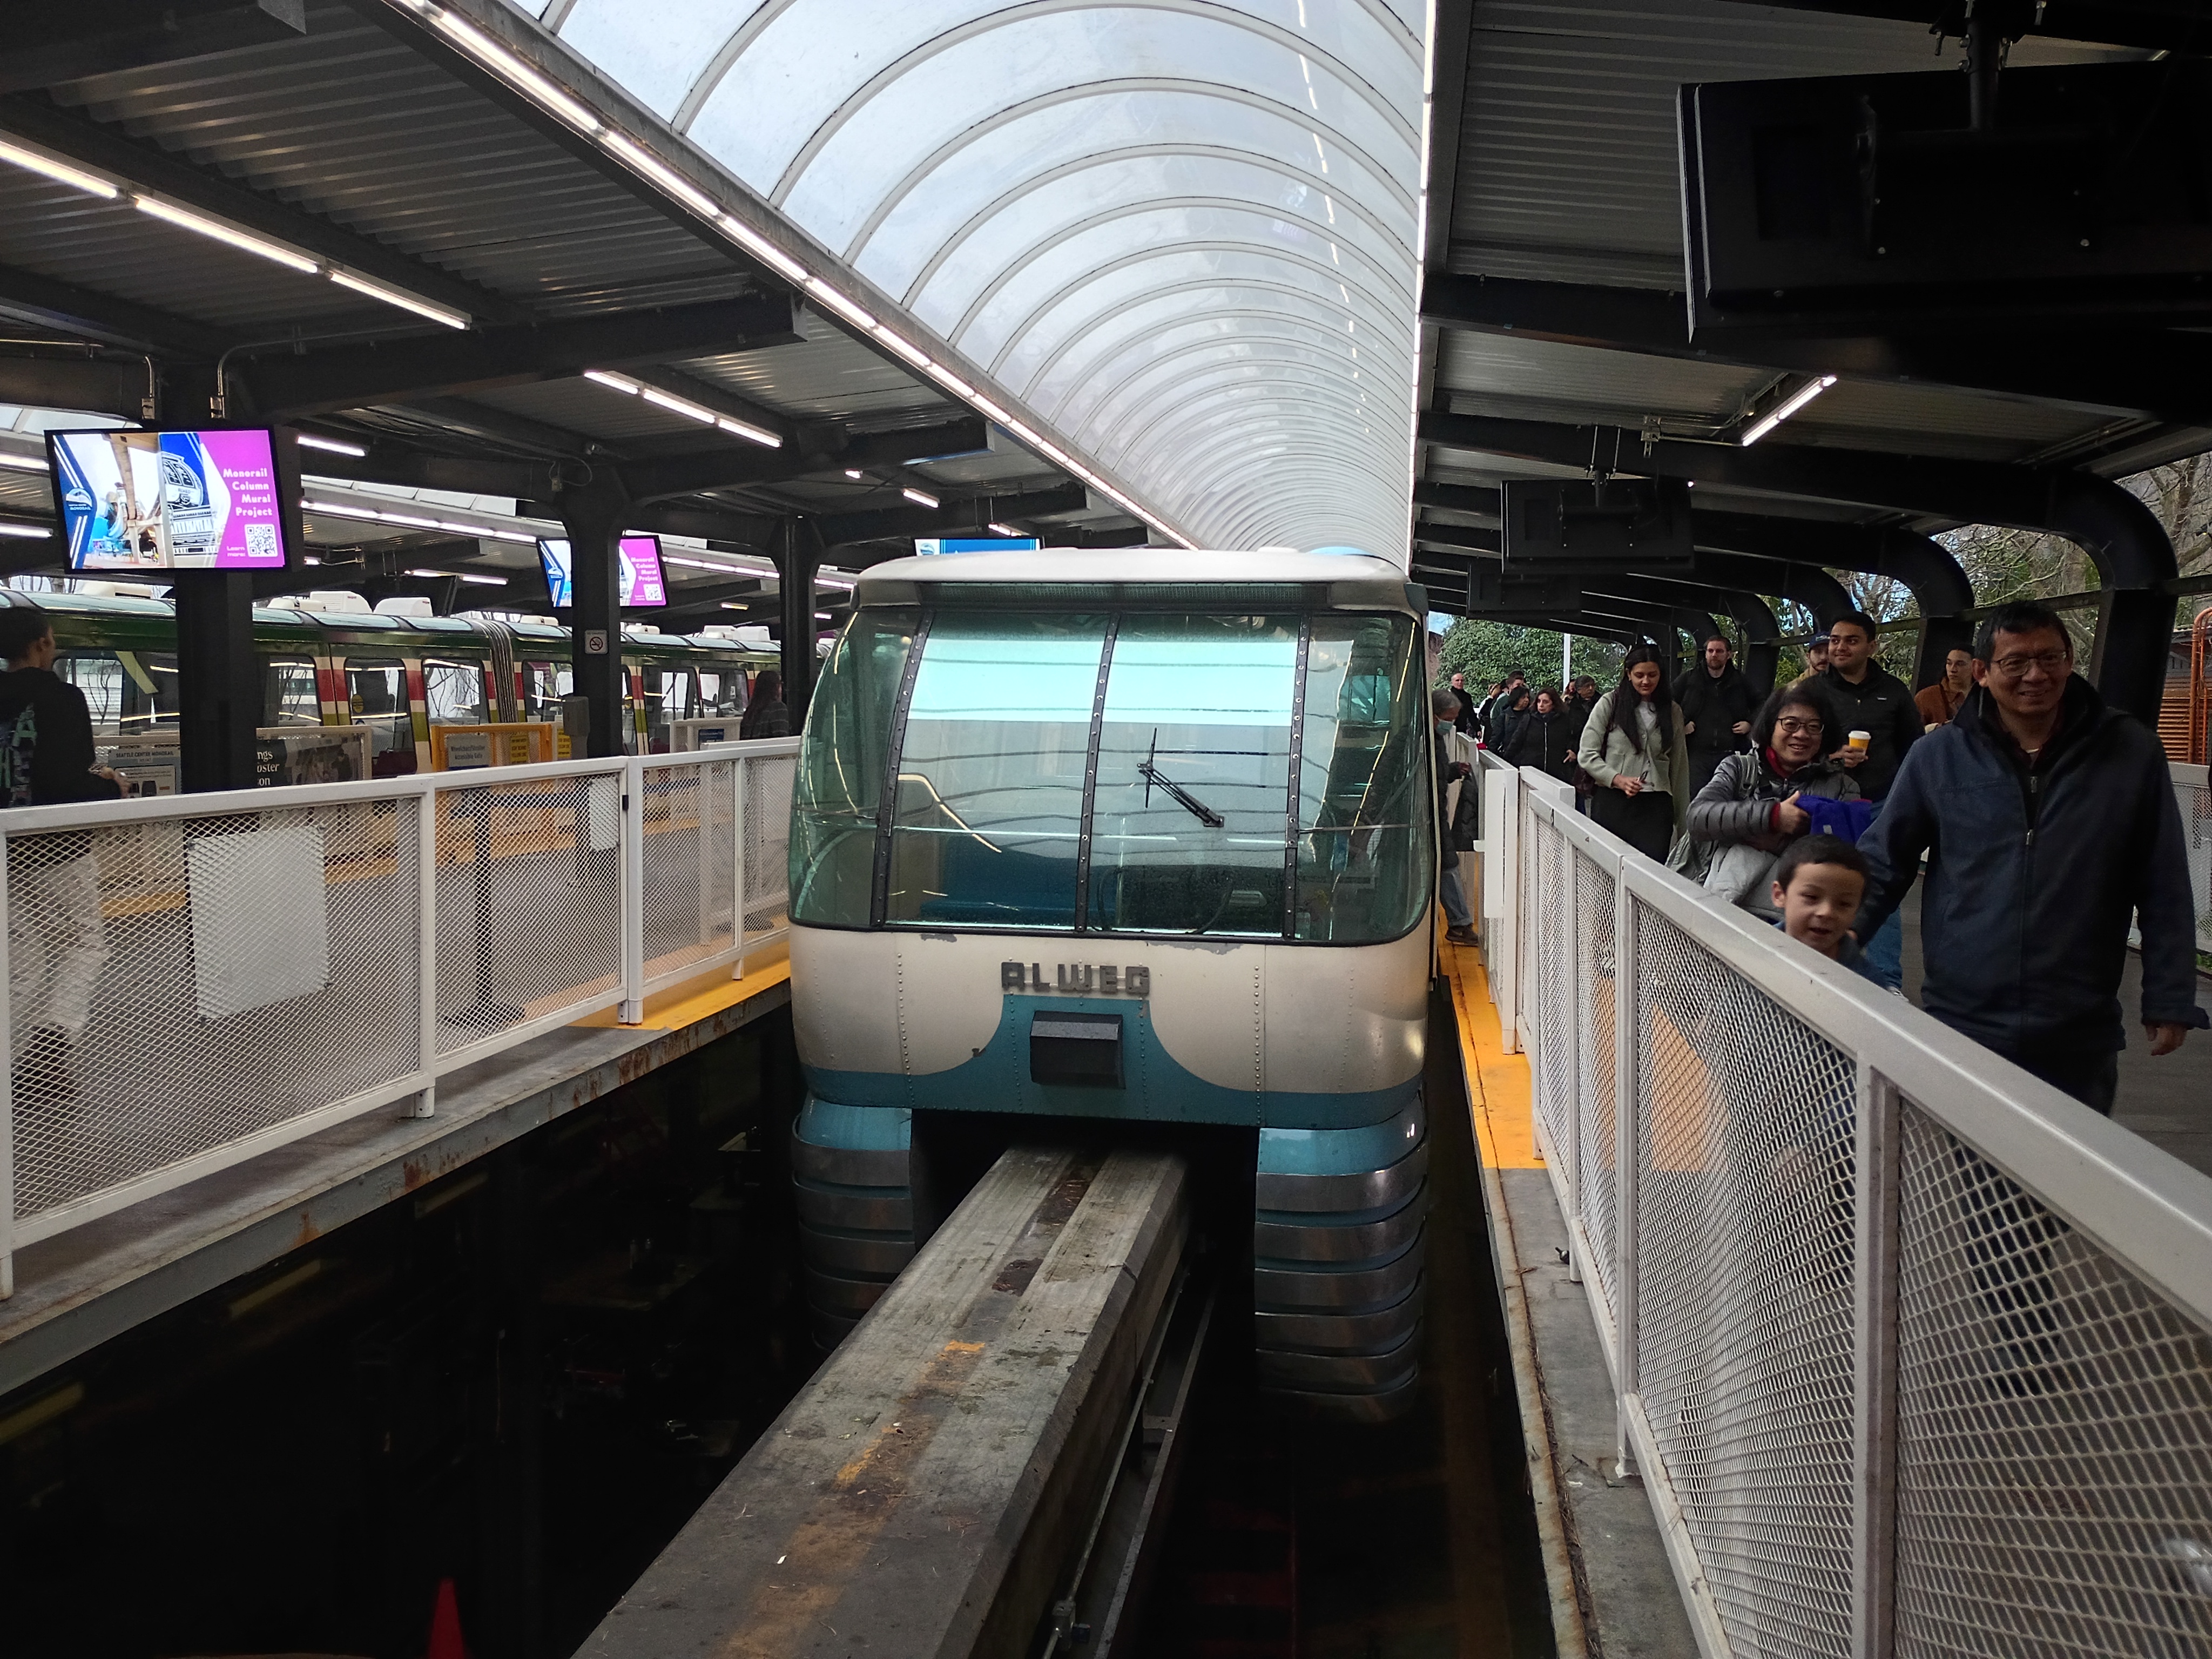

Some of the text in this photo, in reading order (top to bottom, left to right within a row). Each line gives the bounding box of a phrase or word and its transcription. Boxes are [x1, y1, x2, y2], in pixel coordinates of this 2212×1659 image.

[223, 468, 268, 477] Monorail
[232, 481, 269, 490] Column
[241, 493, 271, 503] Mural
[235, 507, 273, 518] Project
[257, 763, 280, 773] oster
[258, 777, 271, 786] on
[1001, 962, 1150, 994] ALWEG
